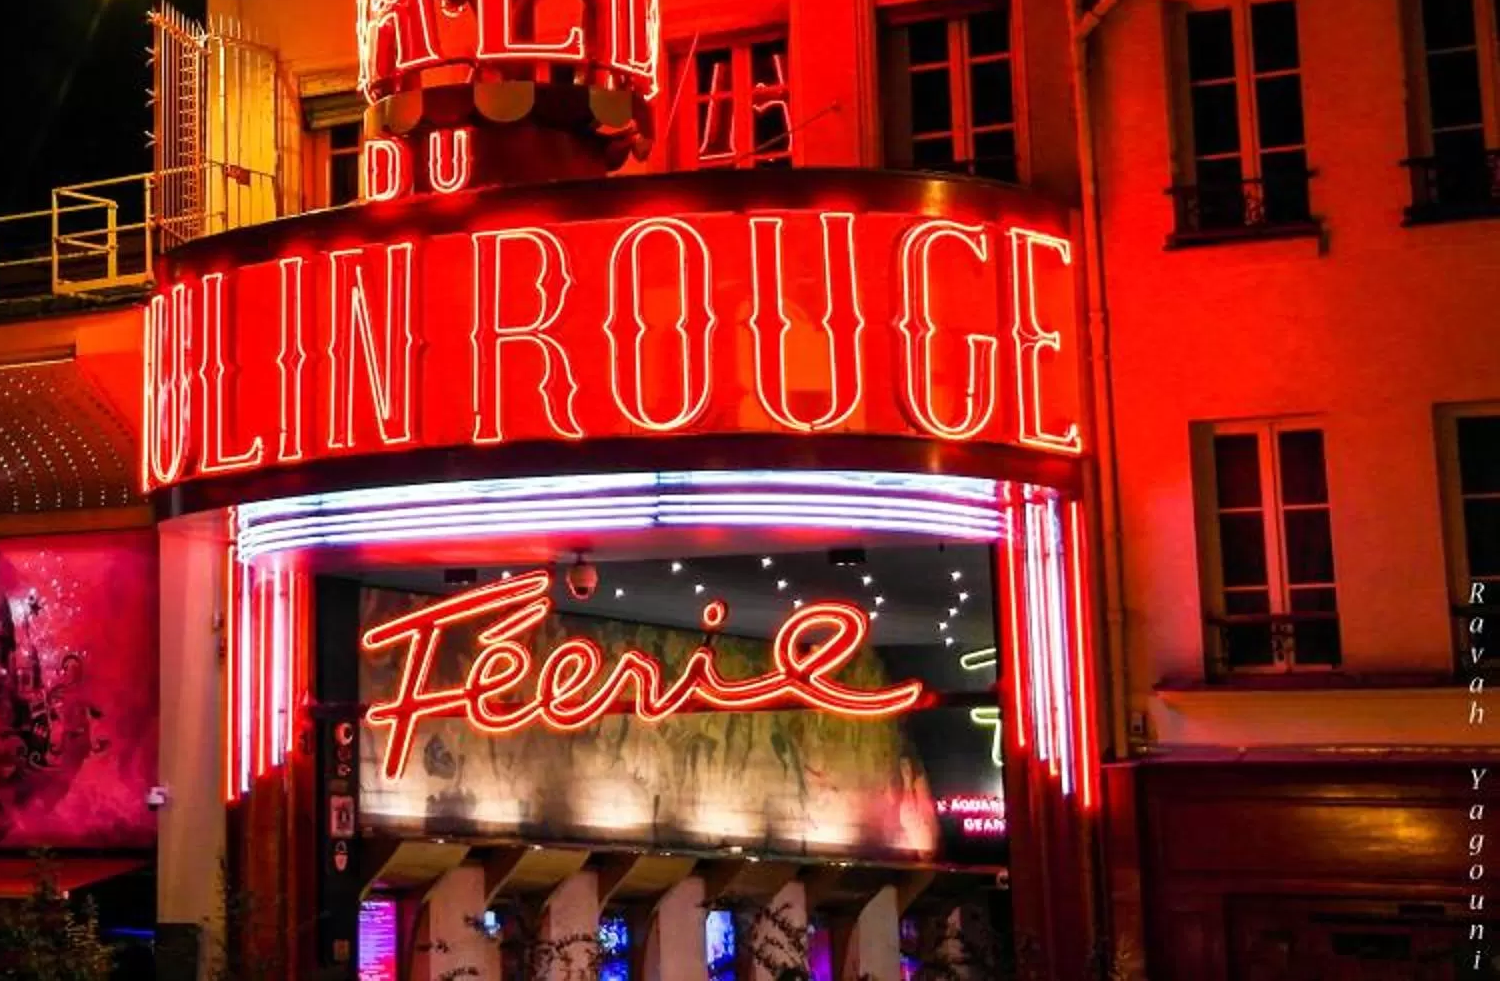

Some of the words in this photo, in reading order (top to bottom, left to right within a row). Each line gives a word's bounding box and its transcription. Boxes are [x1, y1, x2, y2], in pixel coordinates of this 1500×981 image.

[363, 130, 469, 202] DU
[142, 241, 414, 493] ULIN
[471, 212, 1083, 454] ROUGE
[361, 569, 925, 781] Féerie
